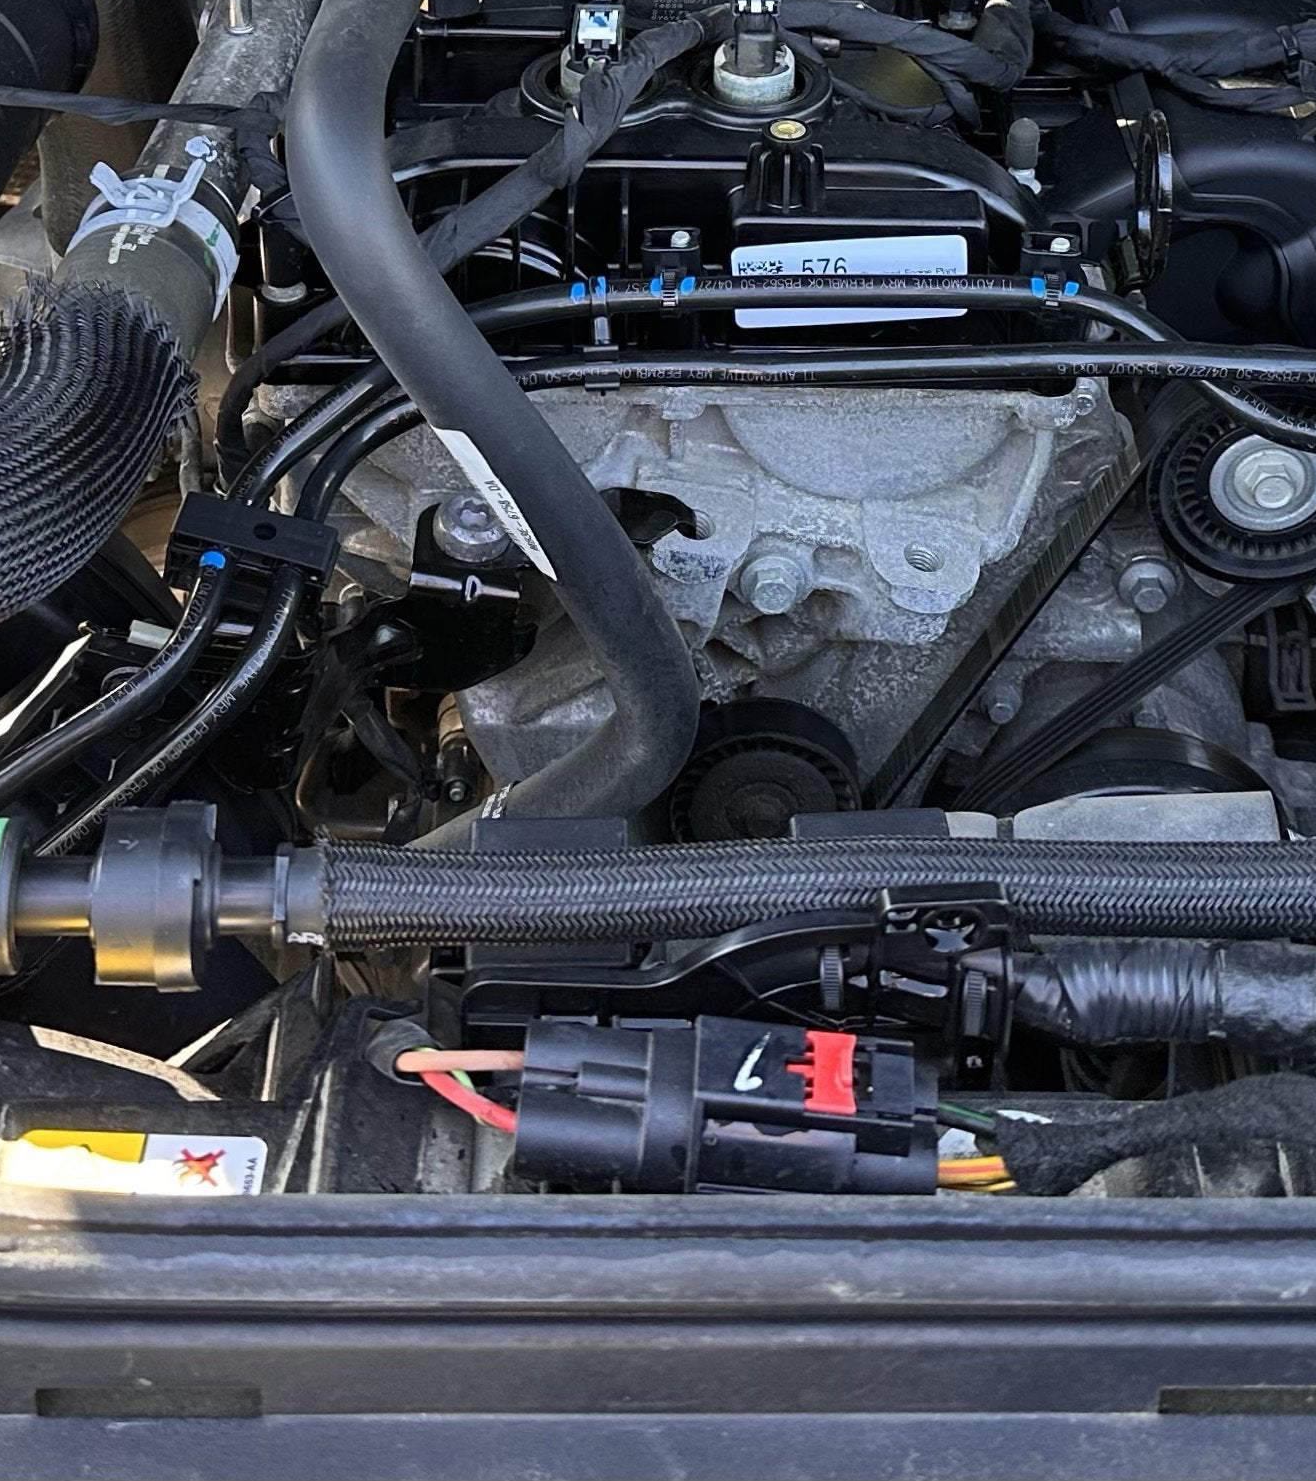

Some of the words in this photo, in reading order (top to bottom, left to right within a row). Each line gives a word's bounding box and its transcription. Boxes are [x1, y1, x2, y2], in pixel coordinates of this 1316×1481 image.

[800, 257, 849, 275] 576
[807, 278, 875, 290] PERMBLOK
[913, 277, 995, 290] AUTOMOTIVE
[717, 367, 797, 382] AUTOMOTIVE
